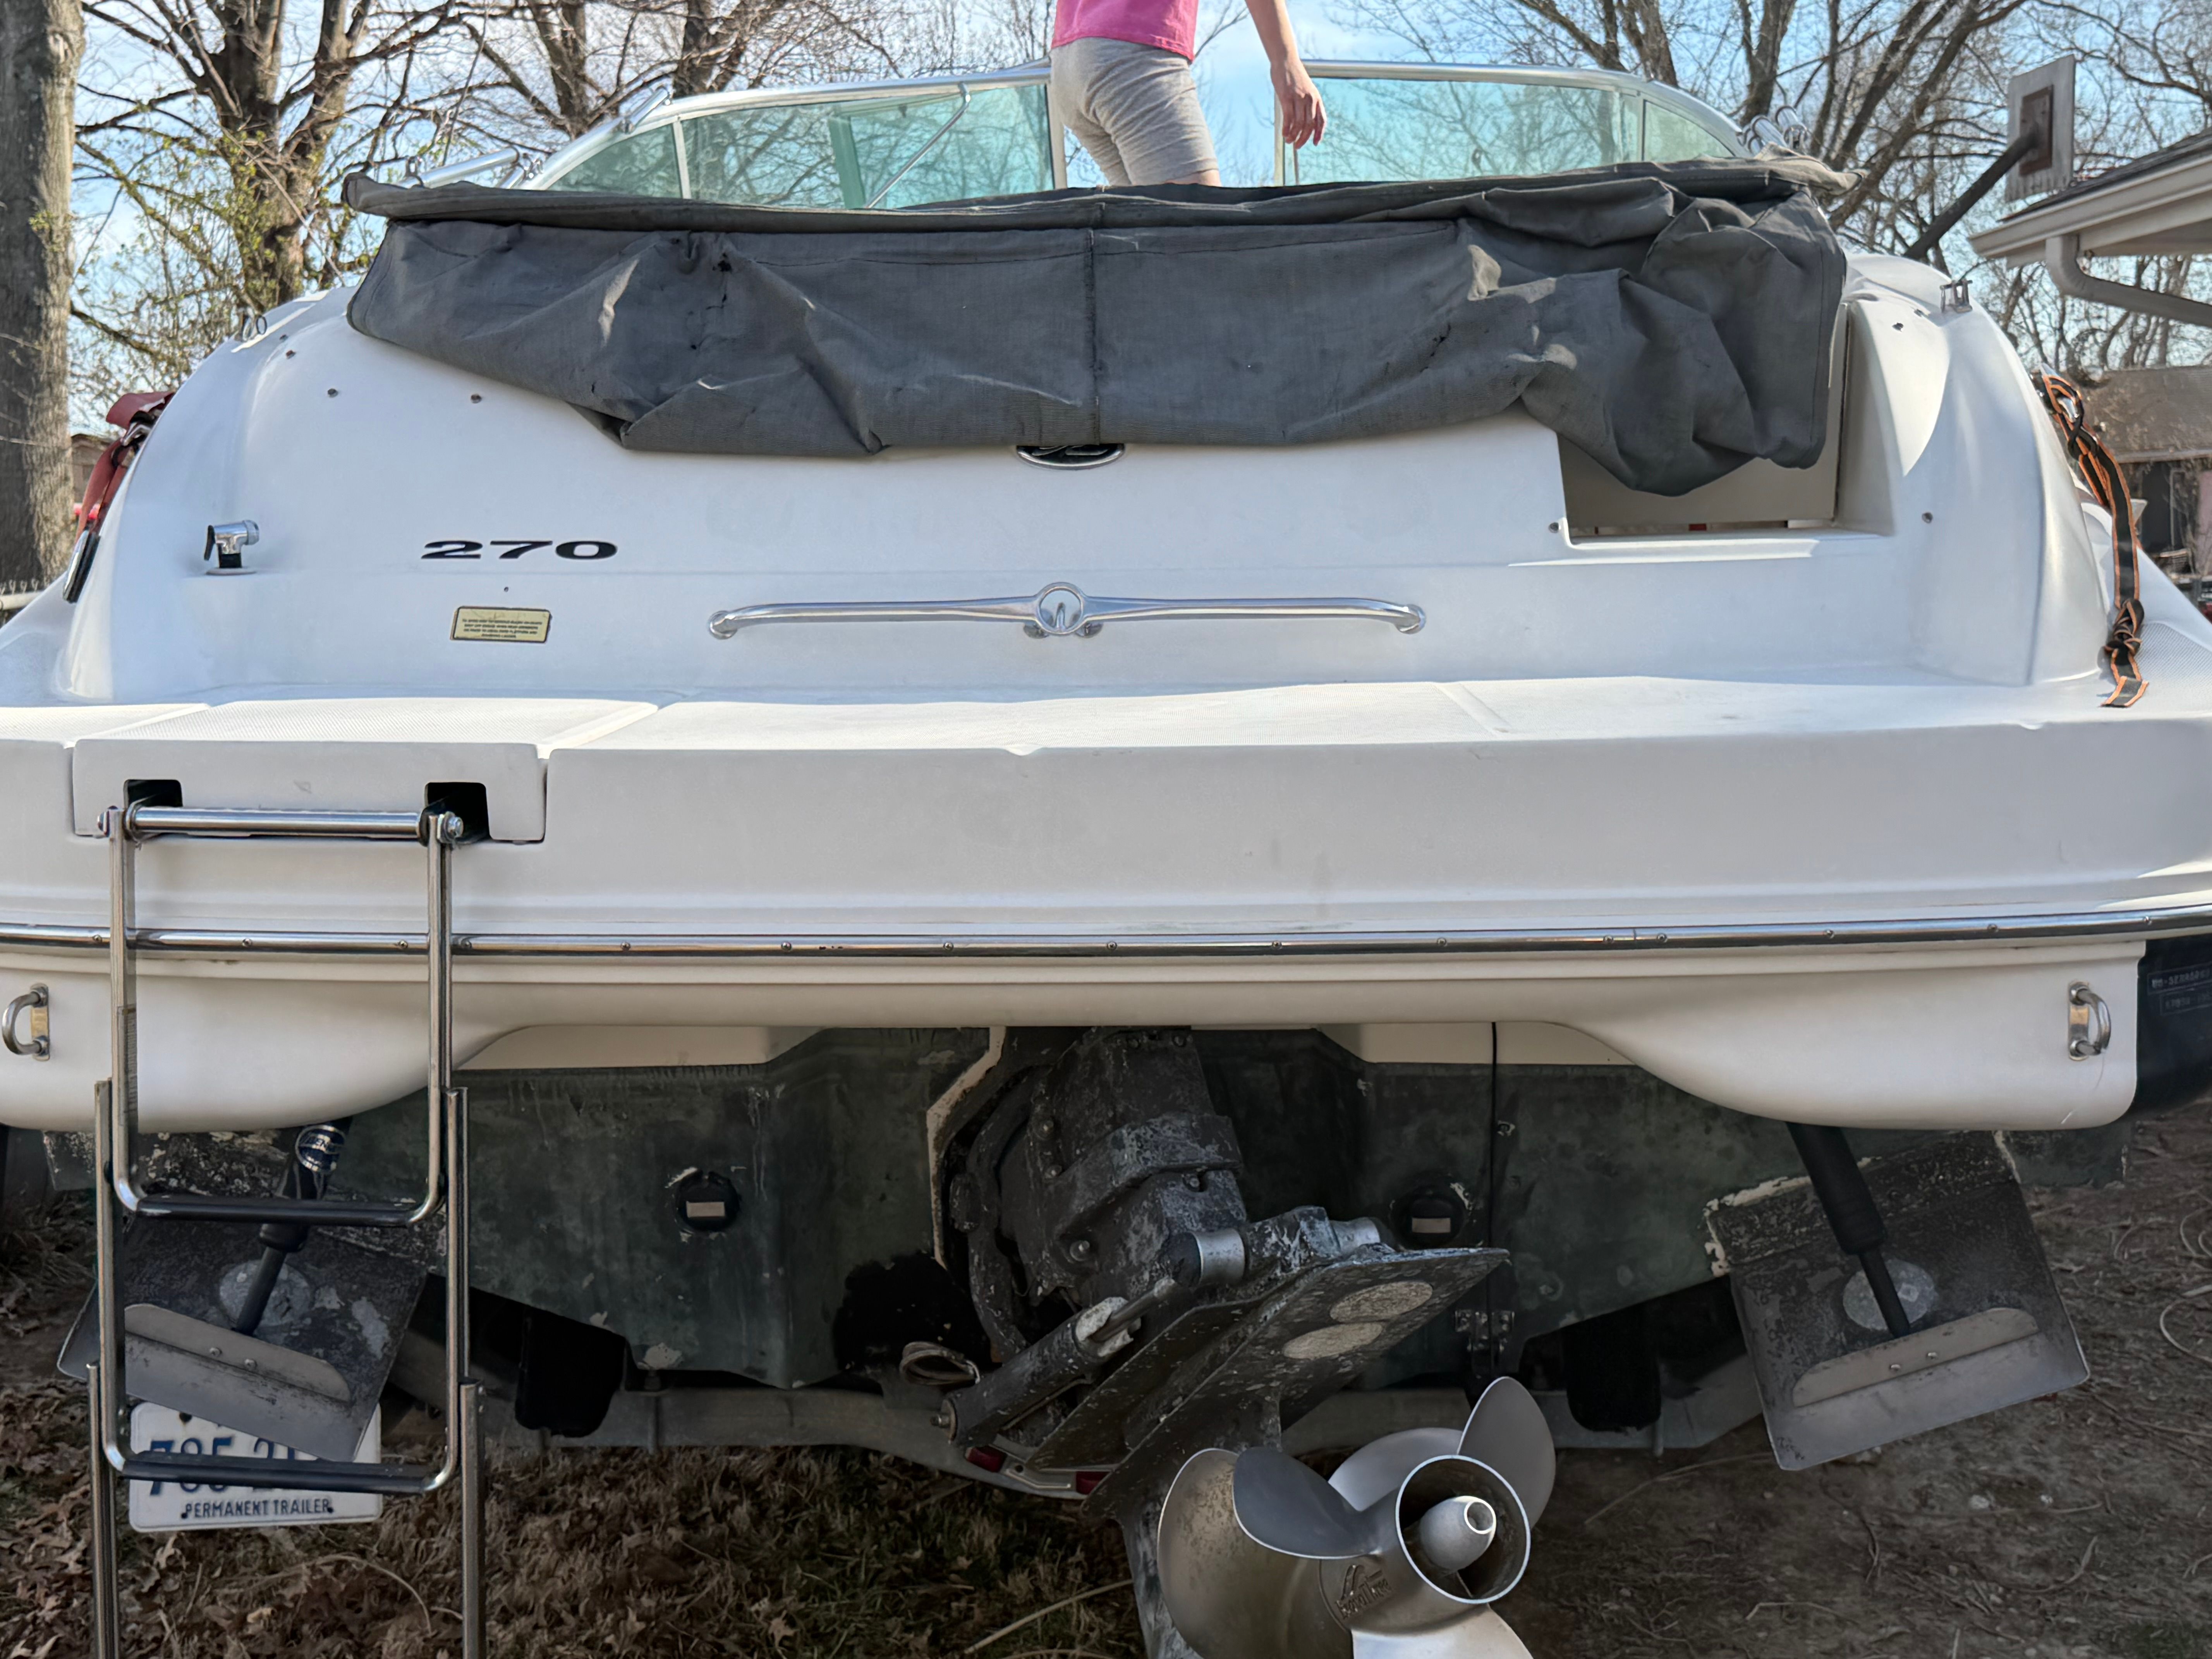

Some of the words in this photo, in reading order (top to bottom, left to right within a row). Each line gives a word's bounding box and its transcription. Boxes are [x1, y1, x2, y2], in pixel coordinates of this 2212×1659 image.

[421, 540, 618, 560] 270
[185, 1500, 269, 1518] PERMANENT
[273, 1498, 330, 1516] TRAILER
